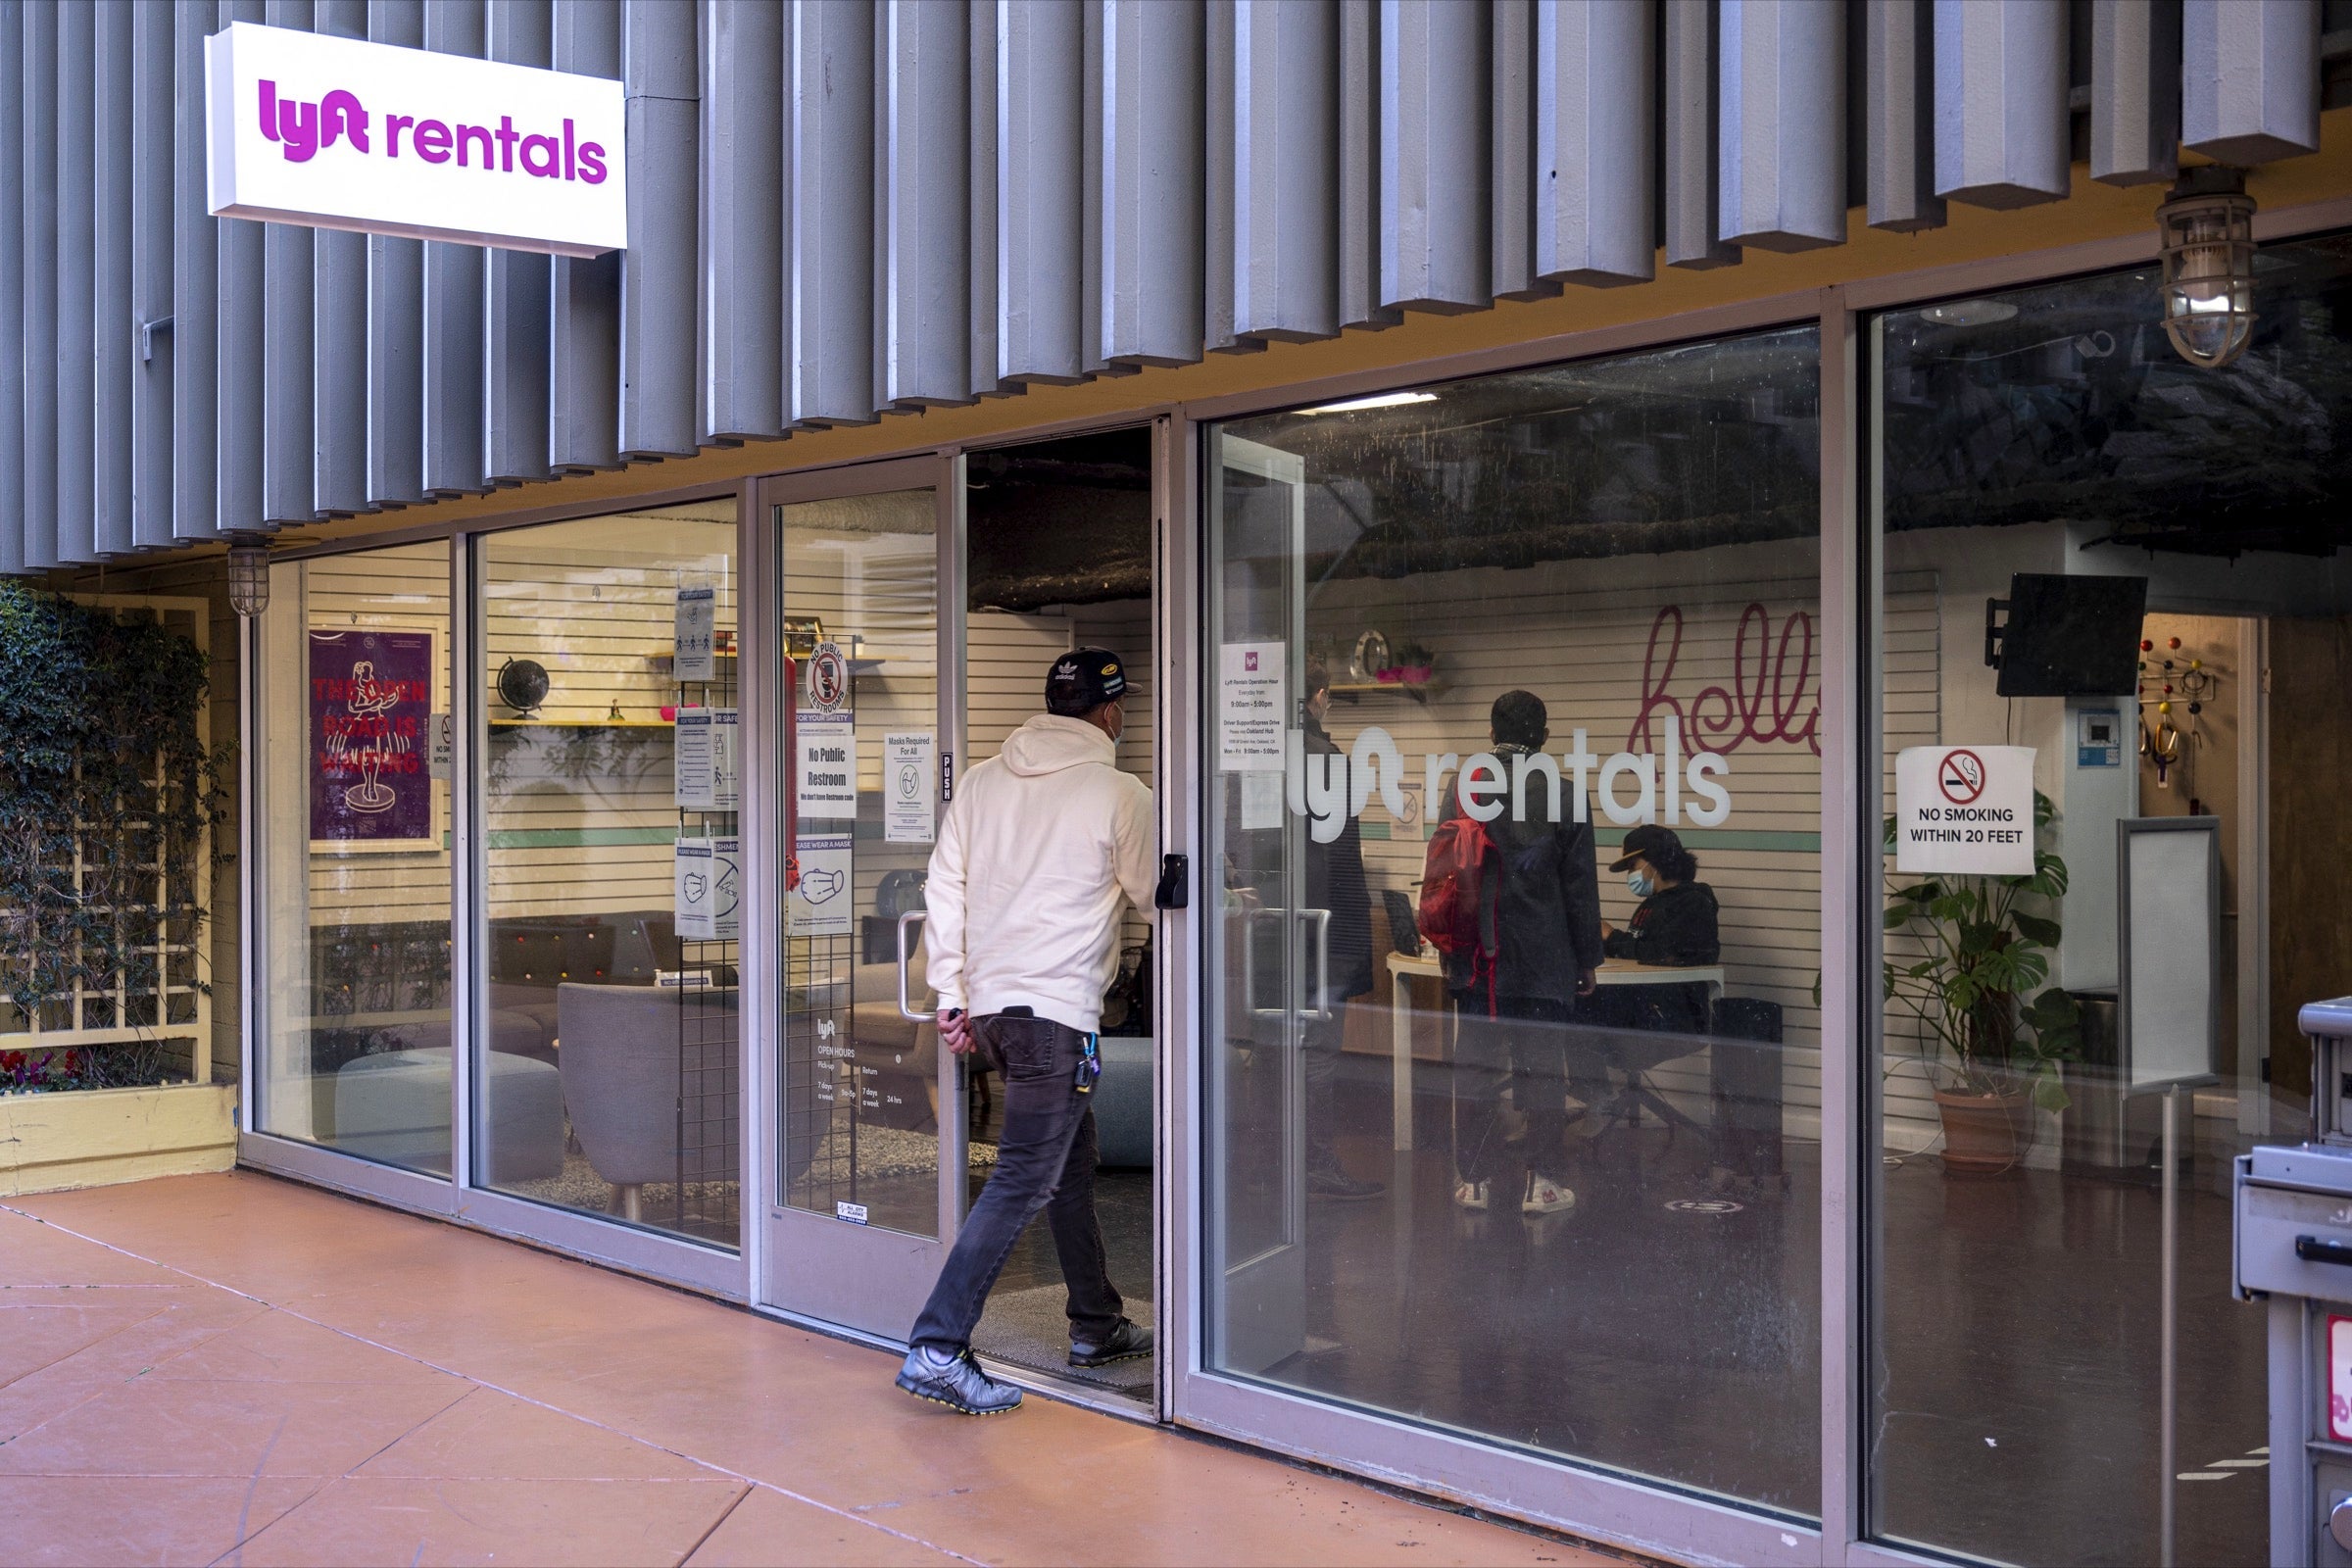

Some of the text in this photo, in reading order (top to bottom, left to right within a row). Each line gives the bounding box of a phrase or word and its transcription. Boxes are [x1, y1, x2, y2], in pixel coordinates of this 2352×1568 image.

[258, 79, 608, 185] lyft rentals
[810, 643, 843, 664] NO PUBLIC
[313, 678, 426, 702] THE OPEN
[809, 690, 844, 713] RESTROOMS
[322, 714, 389, 737] ROAD
[396, 715, 416, 737] IS
[906, 737, 930, 746] Required
[808, 748, 845, 762] No Public
[318, 752, 419, 774] WAITING
[808, 772, 846, 786] Restroom
[1287, 715, 1731, 843] lyft rentals
[1919, 808, 2013, 822] NO SMOKING
[1911, 829, 2023, 843] WITHIN 20 FEET
[818, 1019, 835, 1040] lyft
[818, 1046, 855, 1058] OPEN HOURS
[818, 1061, 834, 1070] Pick-up
[862, 1067, 878, 1075] Return
[821, 1082, 832, 1091] days
[866, 1088, 878, 1098] days
[894, 1096, 902, 1104] hrs
